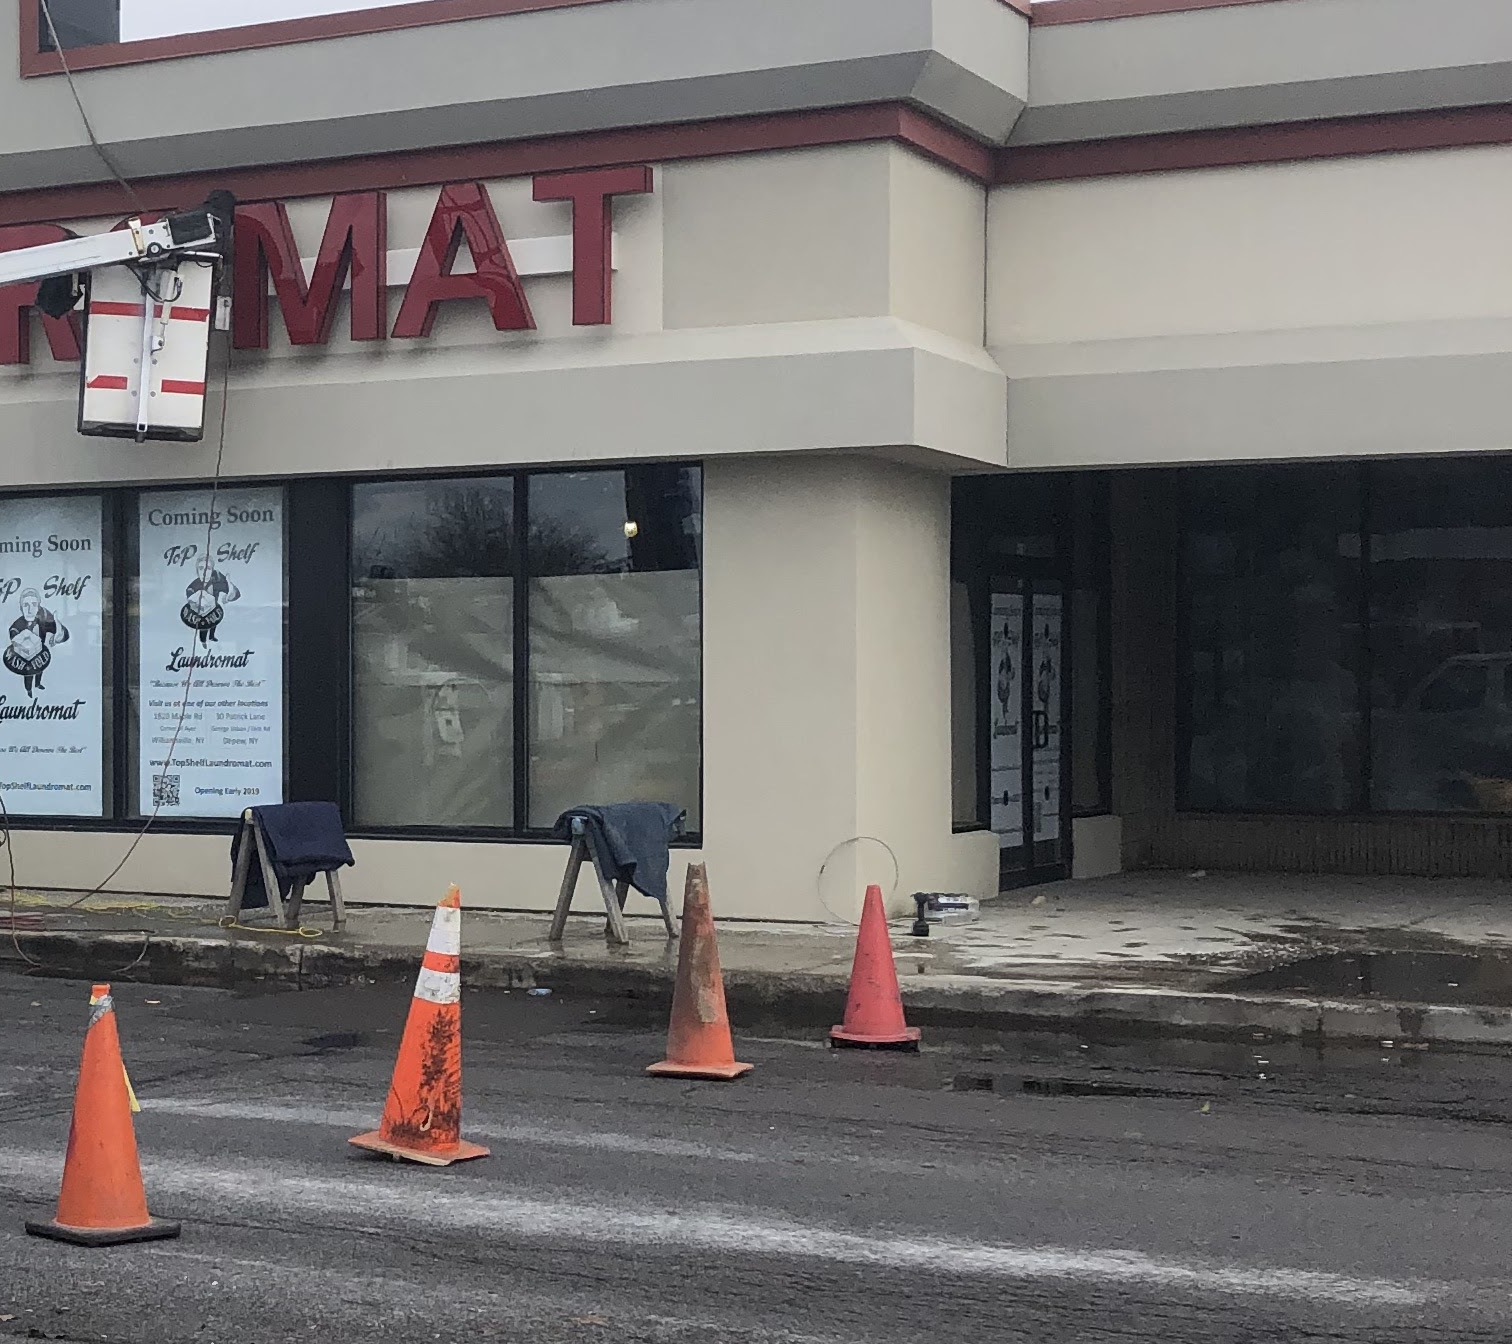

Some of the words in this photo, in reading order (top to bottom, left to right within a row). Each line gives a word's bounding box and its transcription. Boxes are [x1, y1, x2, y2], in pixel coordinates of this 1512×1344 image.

[148, 507, 222, 530] Coming
[226, 505, 275, 524] Soon
[47, 534, 92, 552] Soon
[216, 542, 260, 564] Shelf
[43, 574, 92, 601] Shelf
[165, 646, 255, 673] Laundromat
[148, 699, 163, 707] Visit
[217, 699, 236, 707] other
[237, 699, 268, 707] locations
[194, 786, 223, 795] Opening
[224, 786, 241, 796] Early
[242, 787, 260, 795] 2019
